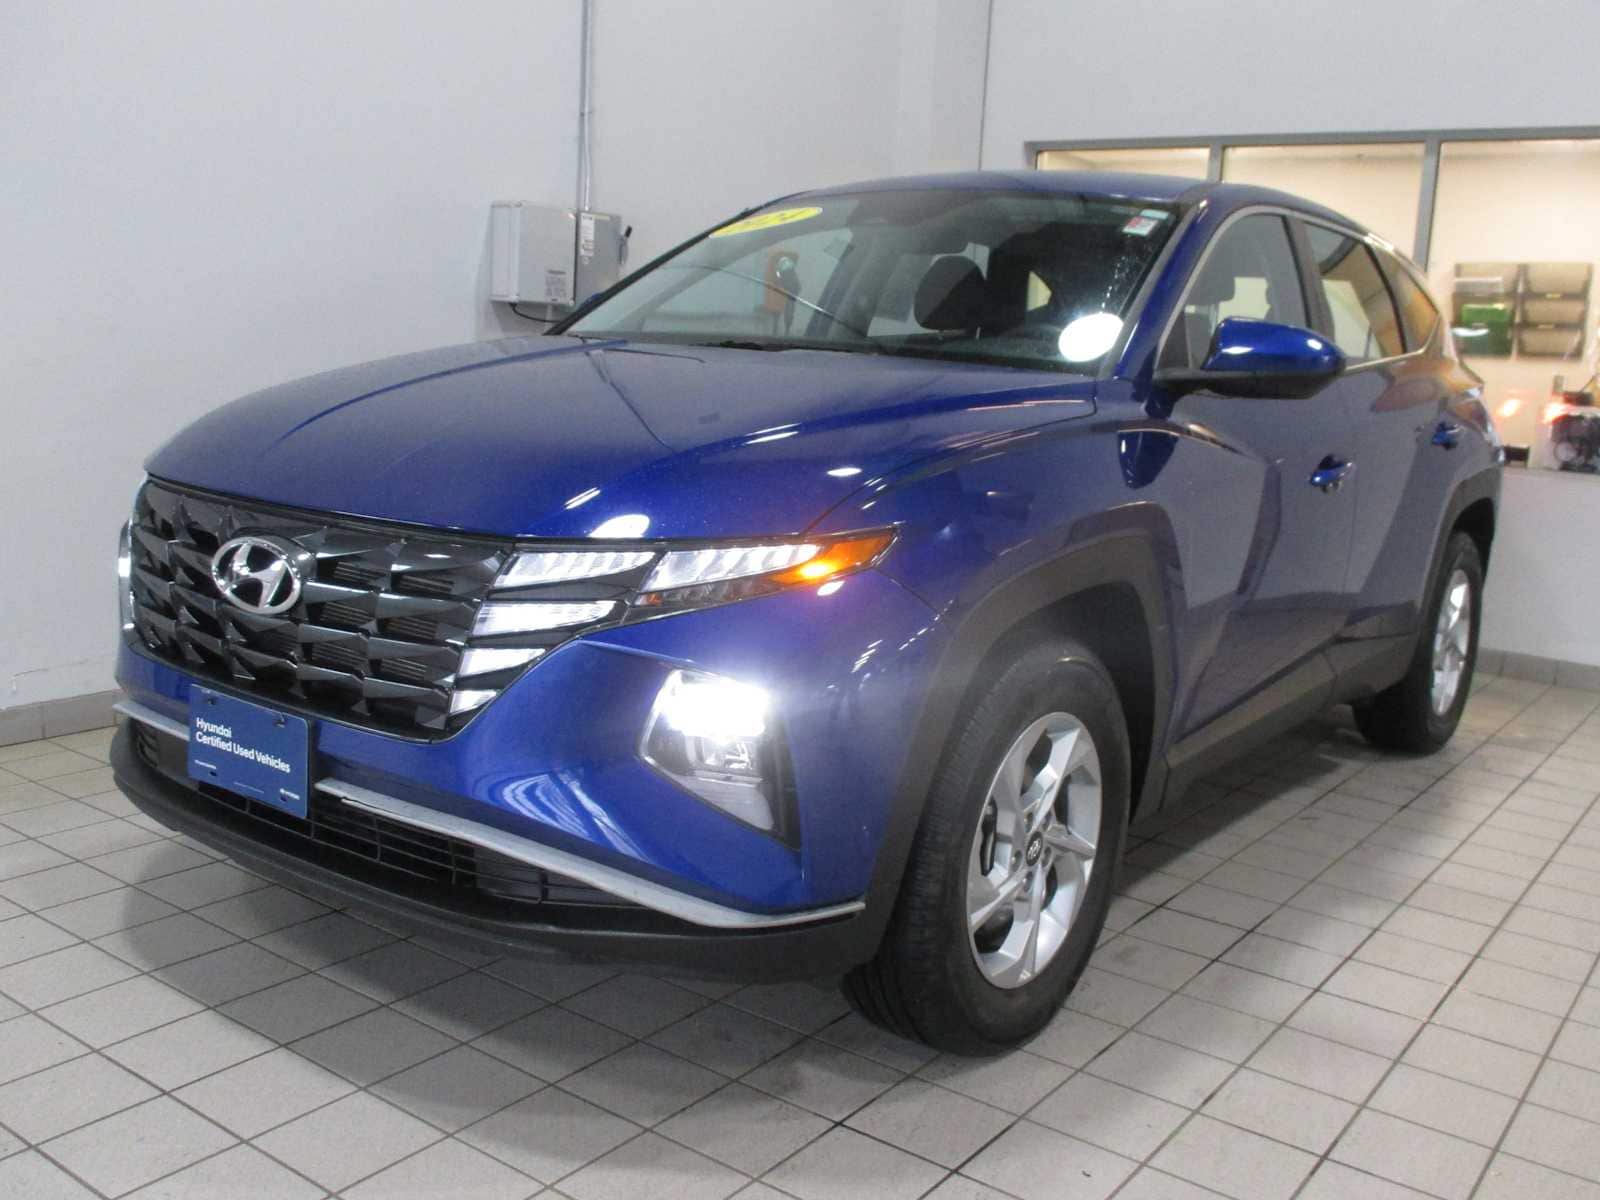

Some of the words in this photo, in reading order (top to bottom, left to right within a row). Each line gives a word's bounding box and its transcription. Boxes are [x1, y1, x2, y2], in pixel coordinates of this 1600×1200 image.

[196, 717, 232, 738] Hyundai
[196, 731, 233, 752] Certified
[233, 743, 255, 760] Used
[255, 750, 291, 773] Vehicles
